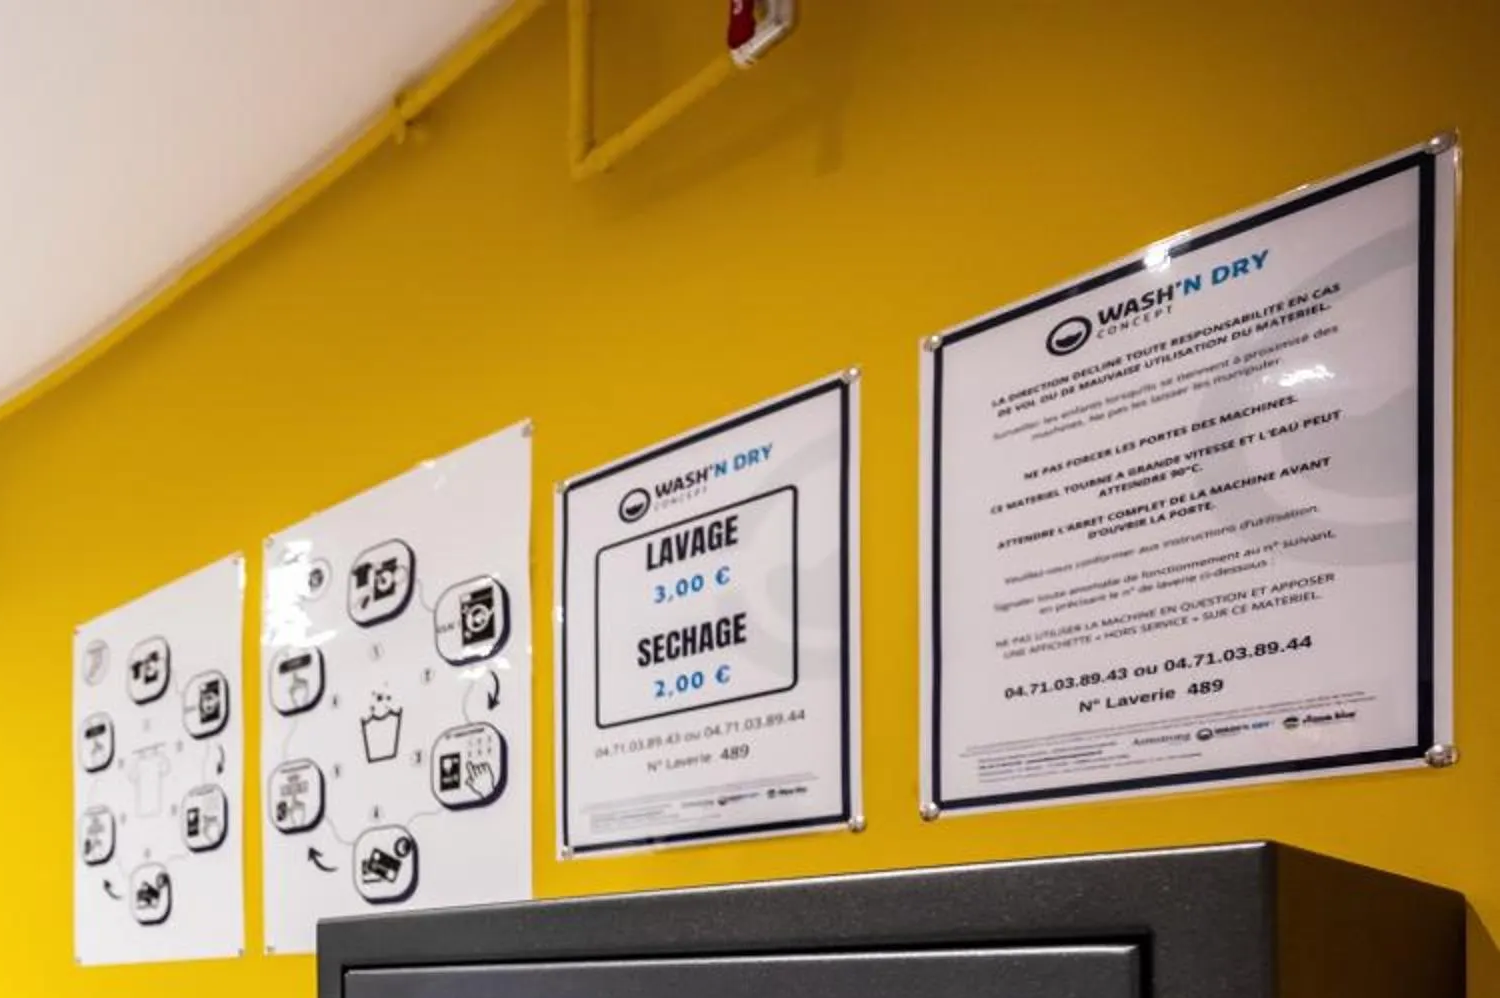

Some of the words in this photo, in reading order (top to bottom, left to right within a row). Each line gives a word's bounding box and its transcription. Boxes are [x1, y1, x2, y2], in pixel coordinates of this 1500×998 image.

[1098, 275, 1202, 326] WASH'N
[1211, 249, 1269, 286] DRY
[1008, 375, 1070, 404] DIRECTION
[1072, 355, 1122, 381] DECLINE
[1126, 337, 1167, 363] TOUTE
[1171, 300, 1285, 347] RESPONSABILITE
[1288, 292, 1308, 309] EN
[1312, 282, 1342, 301] CAS
[1096, 305, 1174, 340] CONCEPT
[1313, 324, 1339, 340] des
[997, 407, 1012, 418] DE
[1040, 390, 1058, 404] OU
[1061, 385, 1076, 398] DE
[1079, 363, 1141, 392] MAUVAISE
[1144, 334, 1228, 370] UTILISATION
[1231, 328, 1251, 342] DU
[654, 461, 728, 499] WASH'N
[733, 443, 774, 473] DRY
[1006, 490, 1060, 511] MATERIEL
[1064, 474, 1113, 495] TOURNE
[1115, 471, 1125, 480] A
[1127, 455, 1181, 477] GRANDE
[1184, 439, 1235, 461] VITESSE
[1239, 433, 1256, 447] ET
[1259, 421, 1299, 441] L'EAU
[1303, 409, 1342, 429] PEUT
[1023, 470, 1038, 480] NE
[1042, 463, 1063, 476] PAS
[1066, 449, 1113, 469] FORCER
[1115, 441, 1136, 455] LES
[1139, 426, 1187, 448] PORTES
[1191, 418, 1217, 433] DES
[997, 528, 1055, 550] ATTENDRE
[1107, 500, 1166, 522] COMPLET
[1169, 494, 1186, 506] DE
[1190, 489, 1207, 501] LA
[1209, 471, 1276, 496] MACHINE
[1280, 456, 1332, 478] AVANT
[1099, 472, 1167, 498] ATTEINDRE
[645, 514, 739, 572] LAVAGE
[1088, 518, 1148, 540] D'OUVRIR
[1150, 513, 1166, 525] LA
[1243, 546, 1261, 557] au
[653, 574, 705, 605] 3,00
[714, 565, 732, 586] €
[1085, 620, 1099, 631] LA
[1102, 607, 1157, 627] MACHINE
[1160, 605, 1178, 616] EN
[1180, 591, 1248, 613] QUESTION
[1251, 585, 1268, 598] ET
[1271, 572, 1336, 594] APPOSER
[636, 612, 748, 668] SECHAGE
[1104, 627, 1137, 640] HORS
[1140, 616, 1189, 634] SERVICE
[1202, 609, 1228, 622] SUR
[1231, 603, 1247, 616] CE
[653, 671, 705, 699] 2,00
[714, 664, 732, 684] €
[1004, 667, 1129, 700] 04.71.03.89.43
[1134, 664, 1158, 678] ou
[1164, 634, 1313, 673] 04.71.03.89.44
[1079, 698, 1101, 713] N°
[1105, 688, 1177, 709] Laverie
[1187, 678, 1225, 696] 489
[684, 729, 700, 742] ou
[703, 708, 807, 739] 04.71.03.89.44
[665, 751, 712, 771] Laverie
[719, 743, 750, 762] 489
